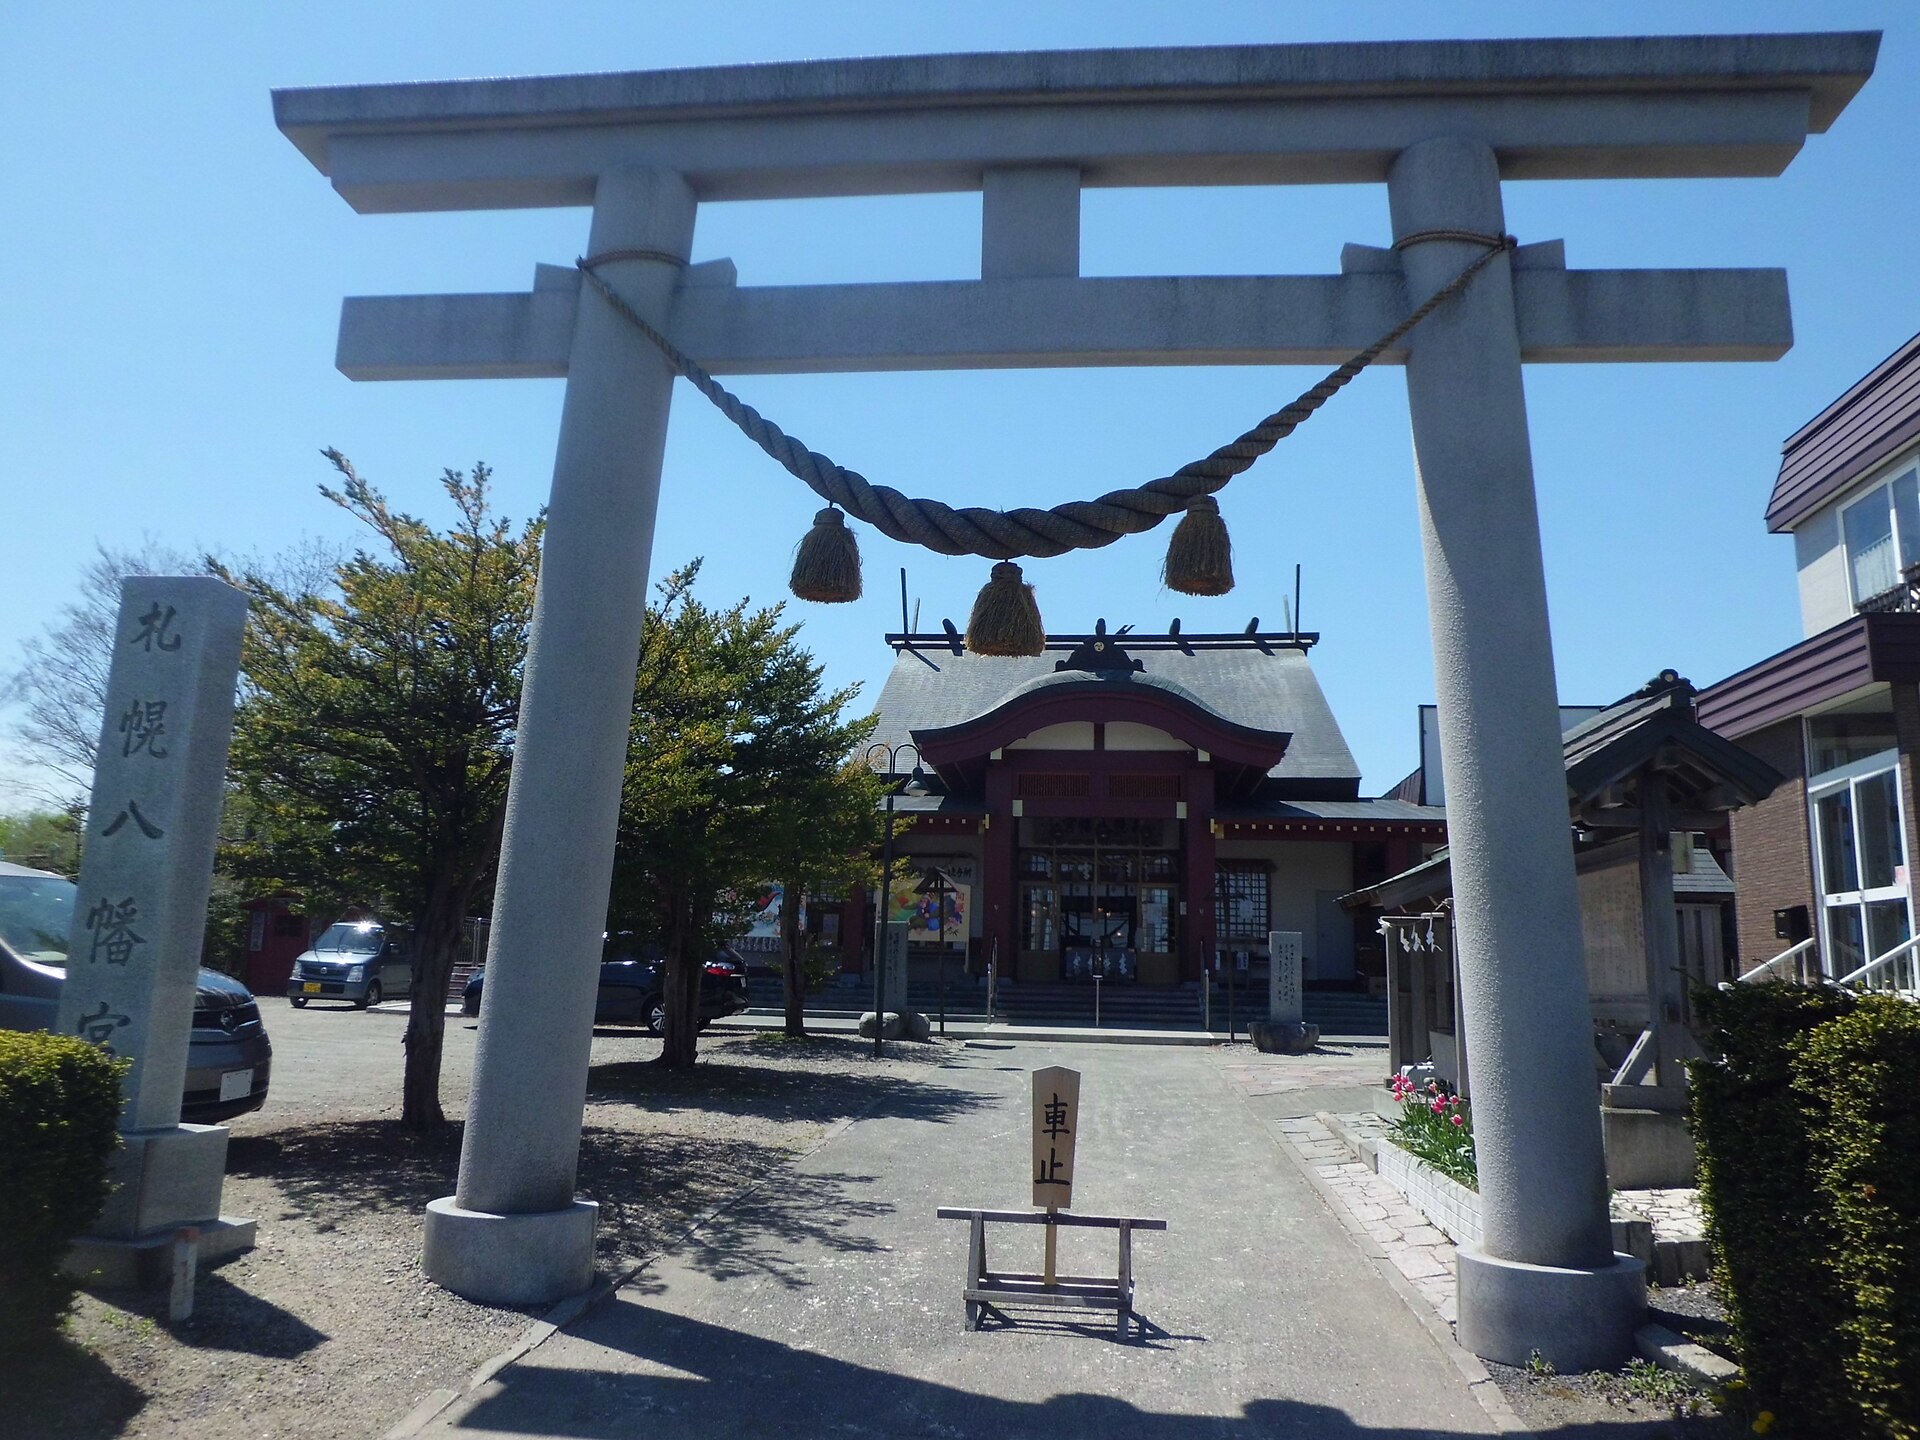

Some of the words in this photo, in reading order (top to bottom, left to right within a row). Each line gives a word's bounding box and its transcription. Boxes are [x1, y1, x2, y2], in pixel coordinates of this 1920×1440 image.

[77, 601, 182, 1059] 札幌八幡宮
[1034, 1092, 1071, 1186] 車止
